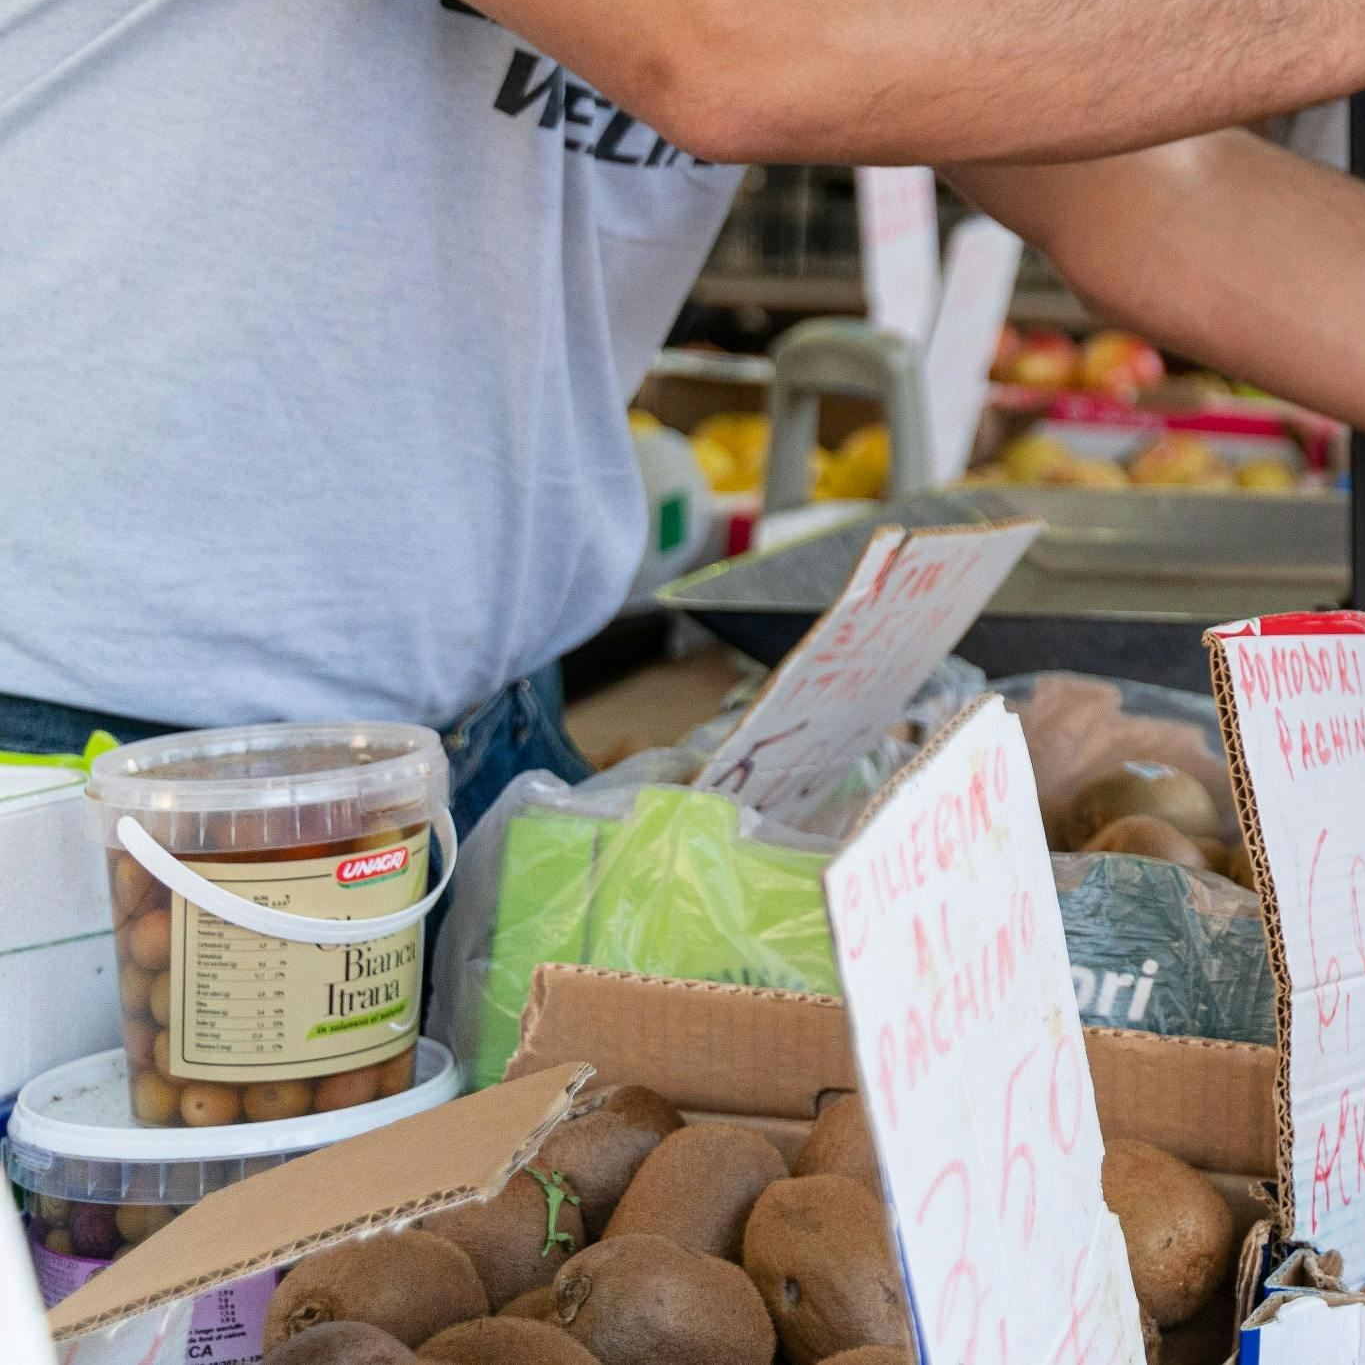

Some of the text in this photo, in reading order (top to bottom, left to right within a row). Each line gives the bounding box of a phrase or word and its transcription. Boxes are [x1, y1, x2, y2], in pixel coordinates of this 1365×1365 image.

[1238, 639, 1364, 711] POMODORI
[342, 848, 407, 879] UNAGRI
[342, 940, 416, 982] Bianca
[325, 978, 400, 1017] Itrana
[877, 890, 1035, 1129] PACHINO
